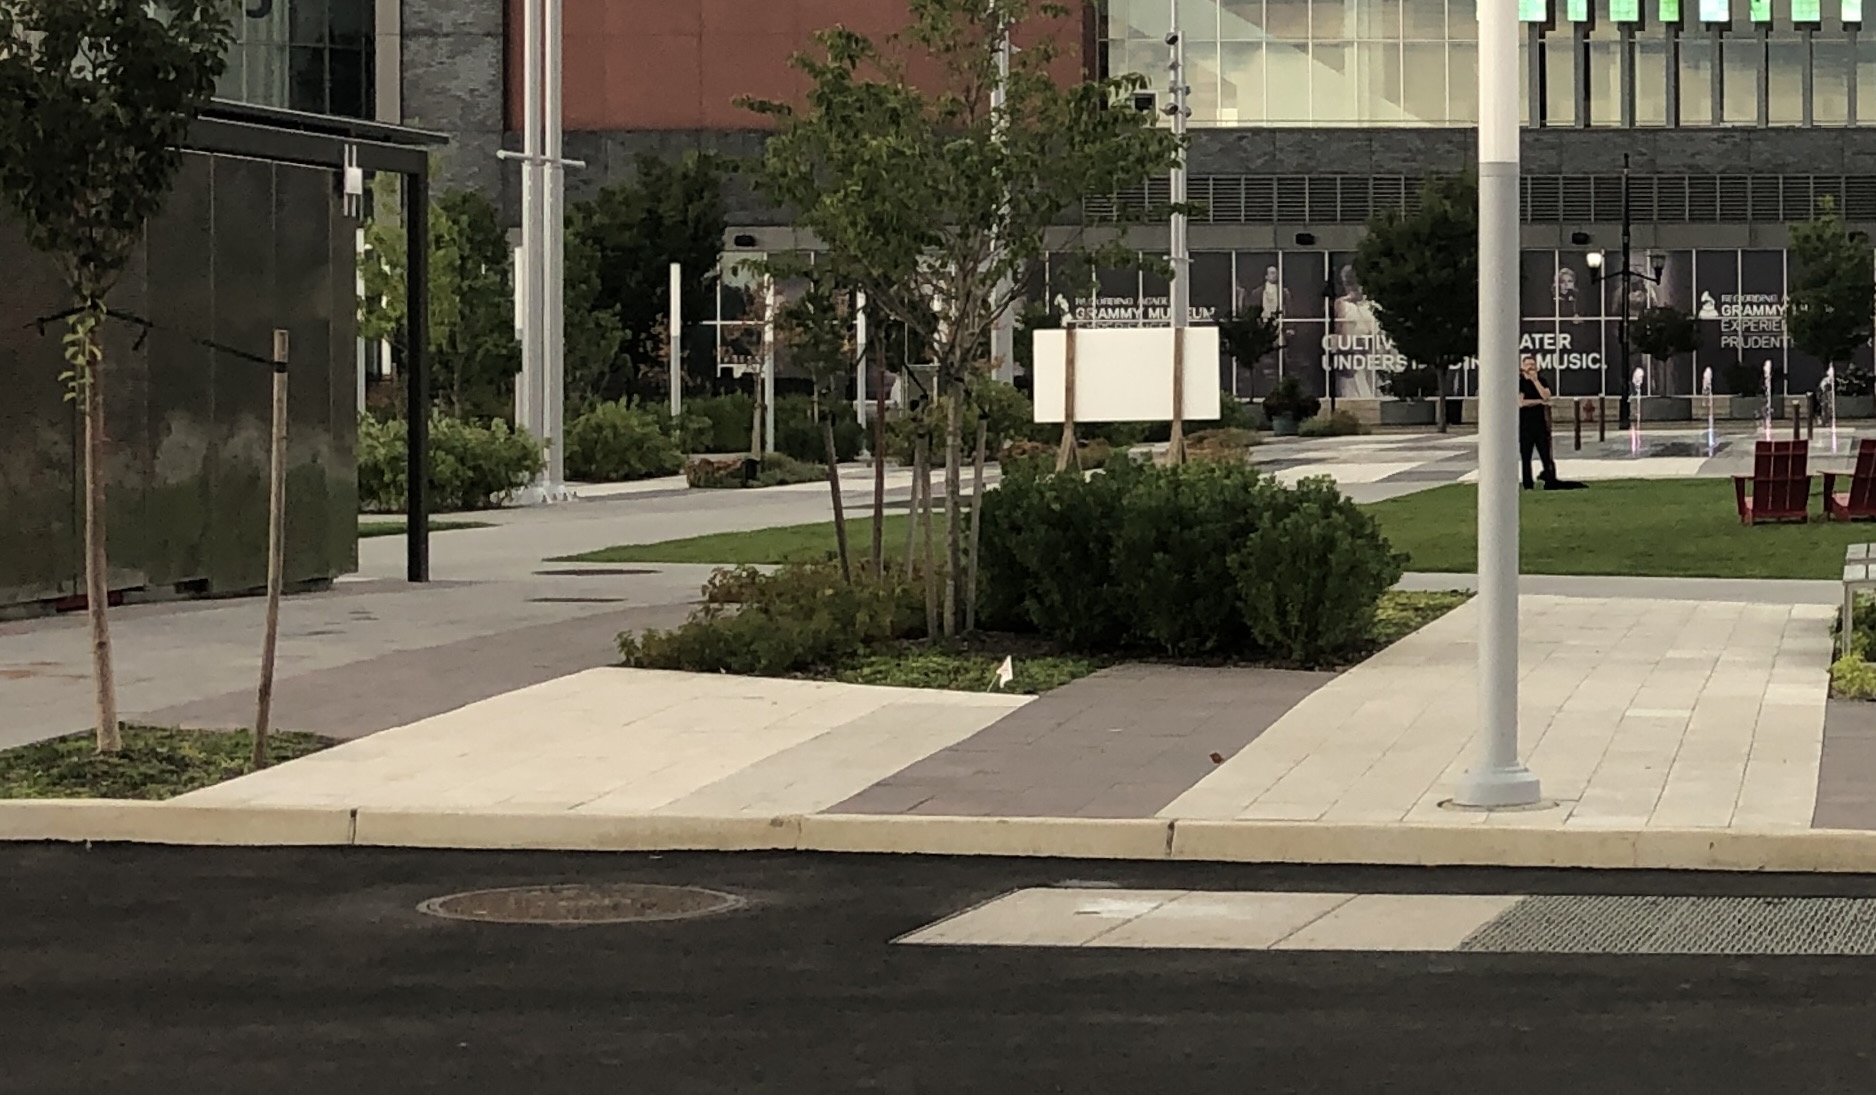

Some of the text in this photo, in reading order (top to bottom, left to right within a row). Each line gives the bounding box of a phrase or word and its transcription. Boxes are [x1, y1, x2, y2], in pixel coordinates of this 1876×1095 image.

[1075, 307, 1210, 320] GRAMMY MUEUM
[1721, 304, 1788, 316] GRAMMY
[1721, 319, 1785, 332] EXPERIE
[1322, 333, 1572, 351] CULTIV ATER
[1721, 335, 1794, 349] PRUDENTI
